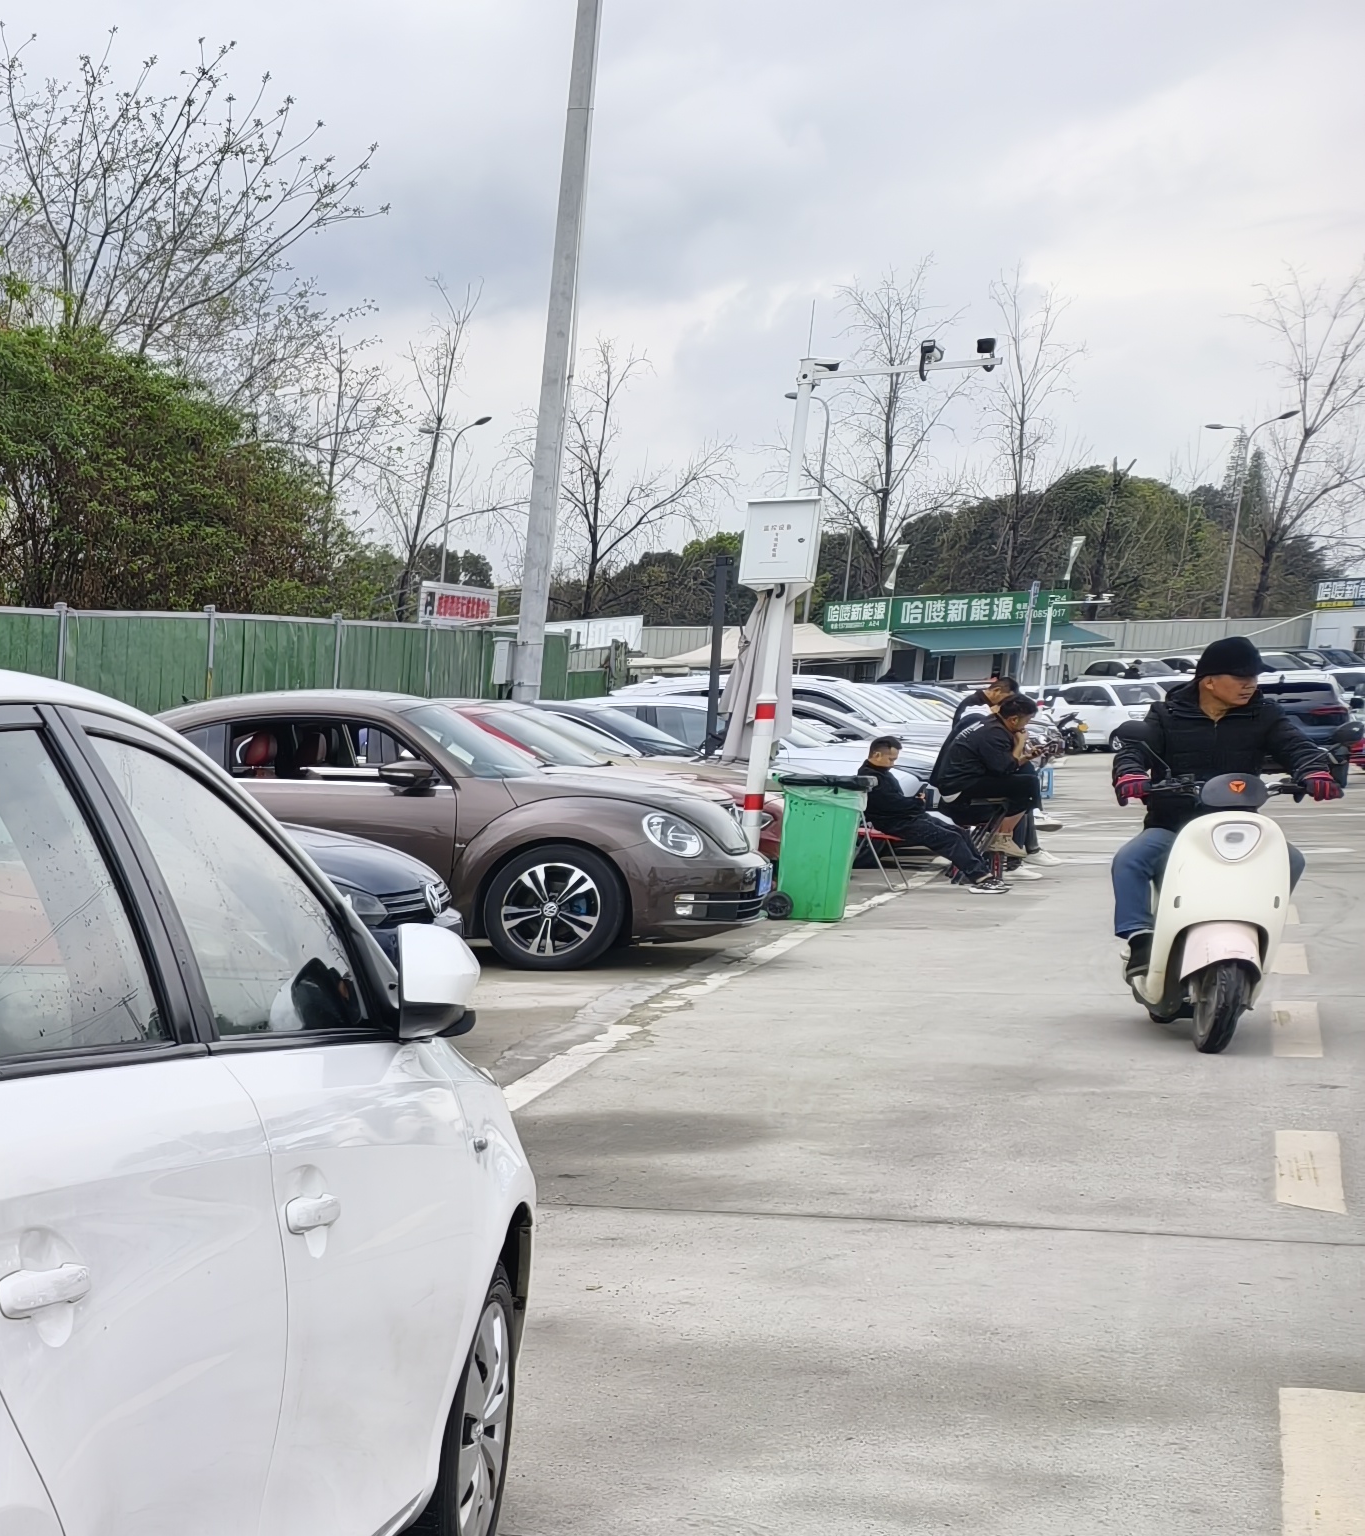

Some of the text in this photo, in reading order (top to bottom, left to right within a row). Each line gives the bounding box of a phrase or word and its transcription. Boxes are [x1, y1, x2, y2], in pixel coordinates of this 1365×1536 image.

[827, 602, 886, 621] 哈喽新能源
[900, 596, 1014, 624] 哈喽新能源
